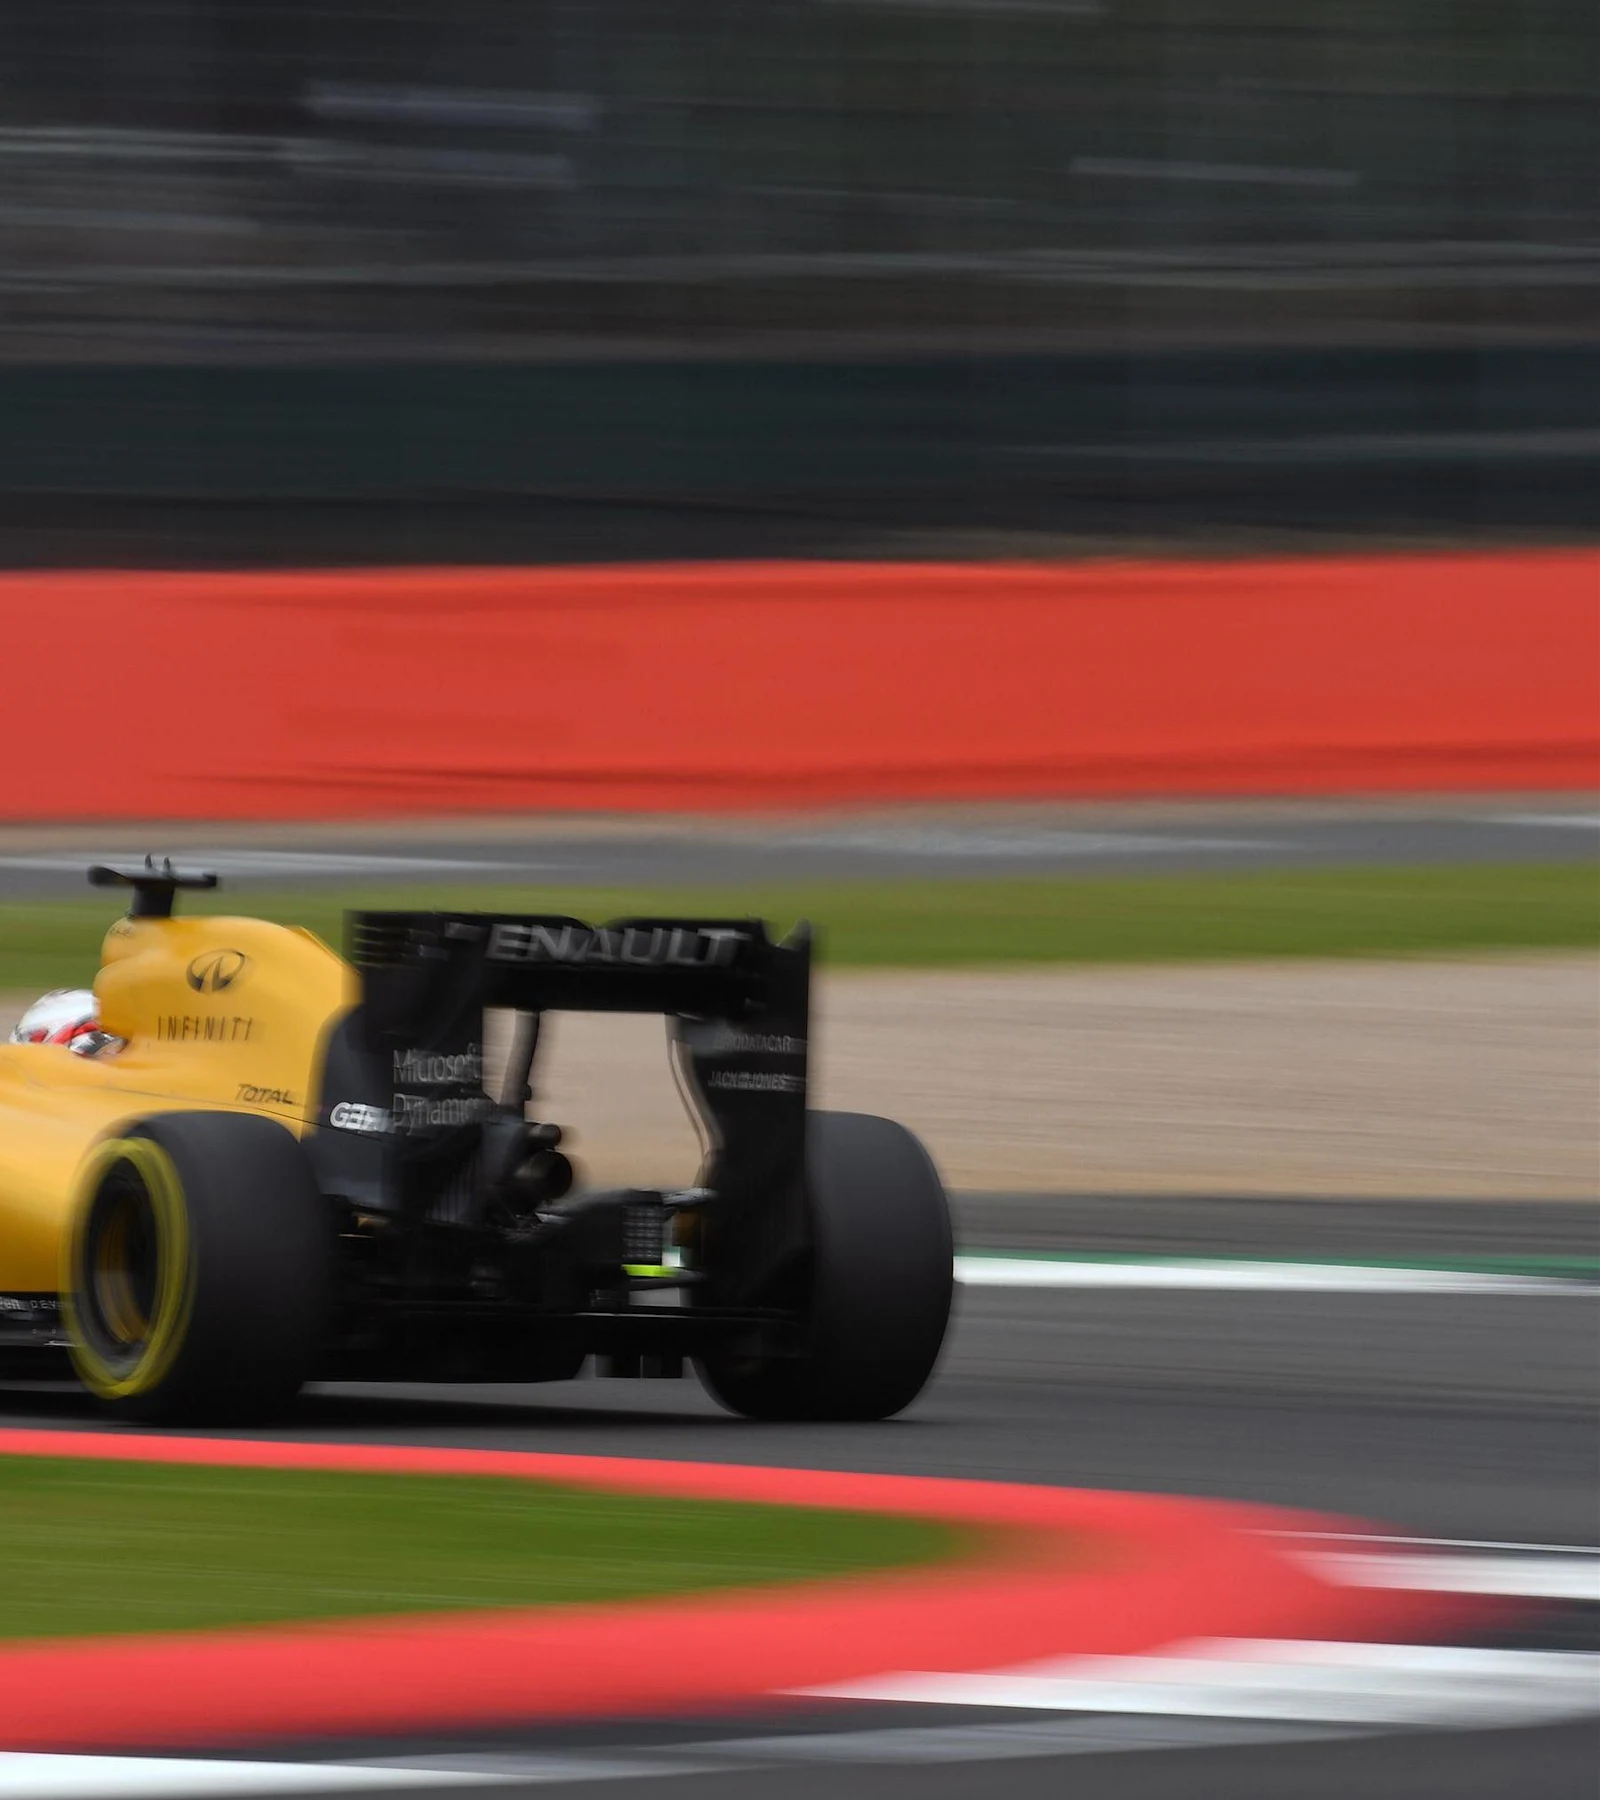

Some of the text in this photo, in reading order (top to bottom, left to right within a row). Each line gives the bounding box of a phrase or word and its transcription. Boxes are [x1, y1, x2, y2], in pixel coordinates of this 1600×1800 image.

[484, 922, 750, 966] ENAULT
[157, 1016, 253, 1041] INFINITI
[235, 1084, 293, 1105] TOTAL
